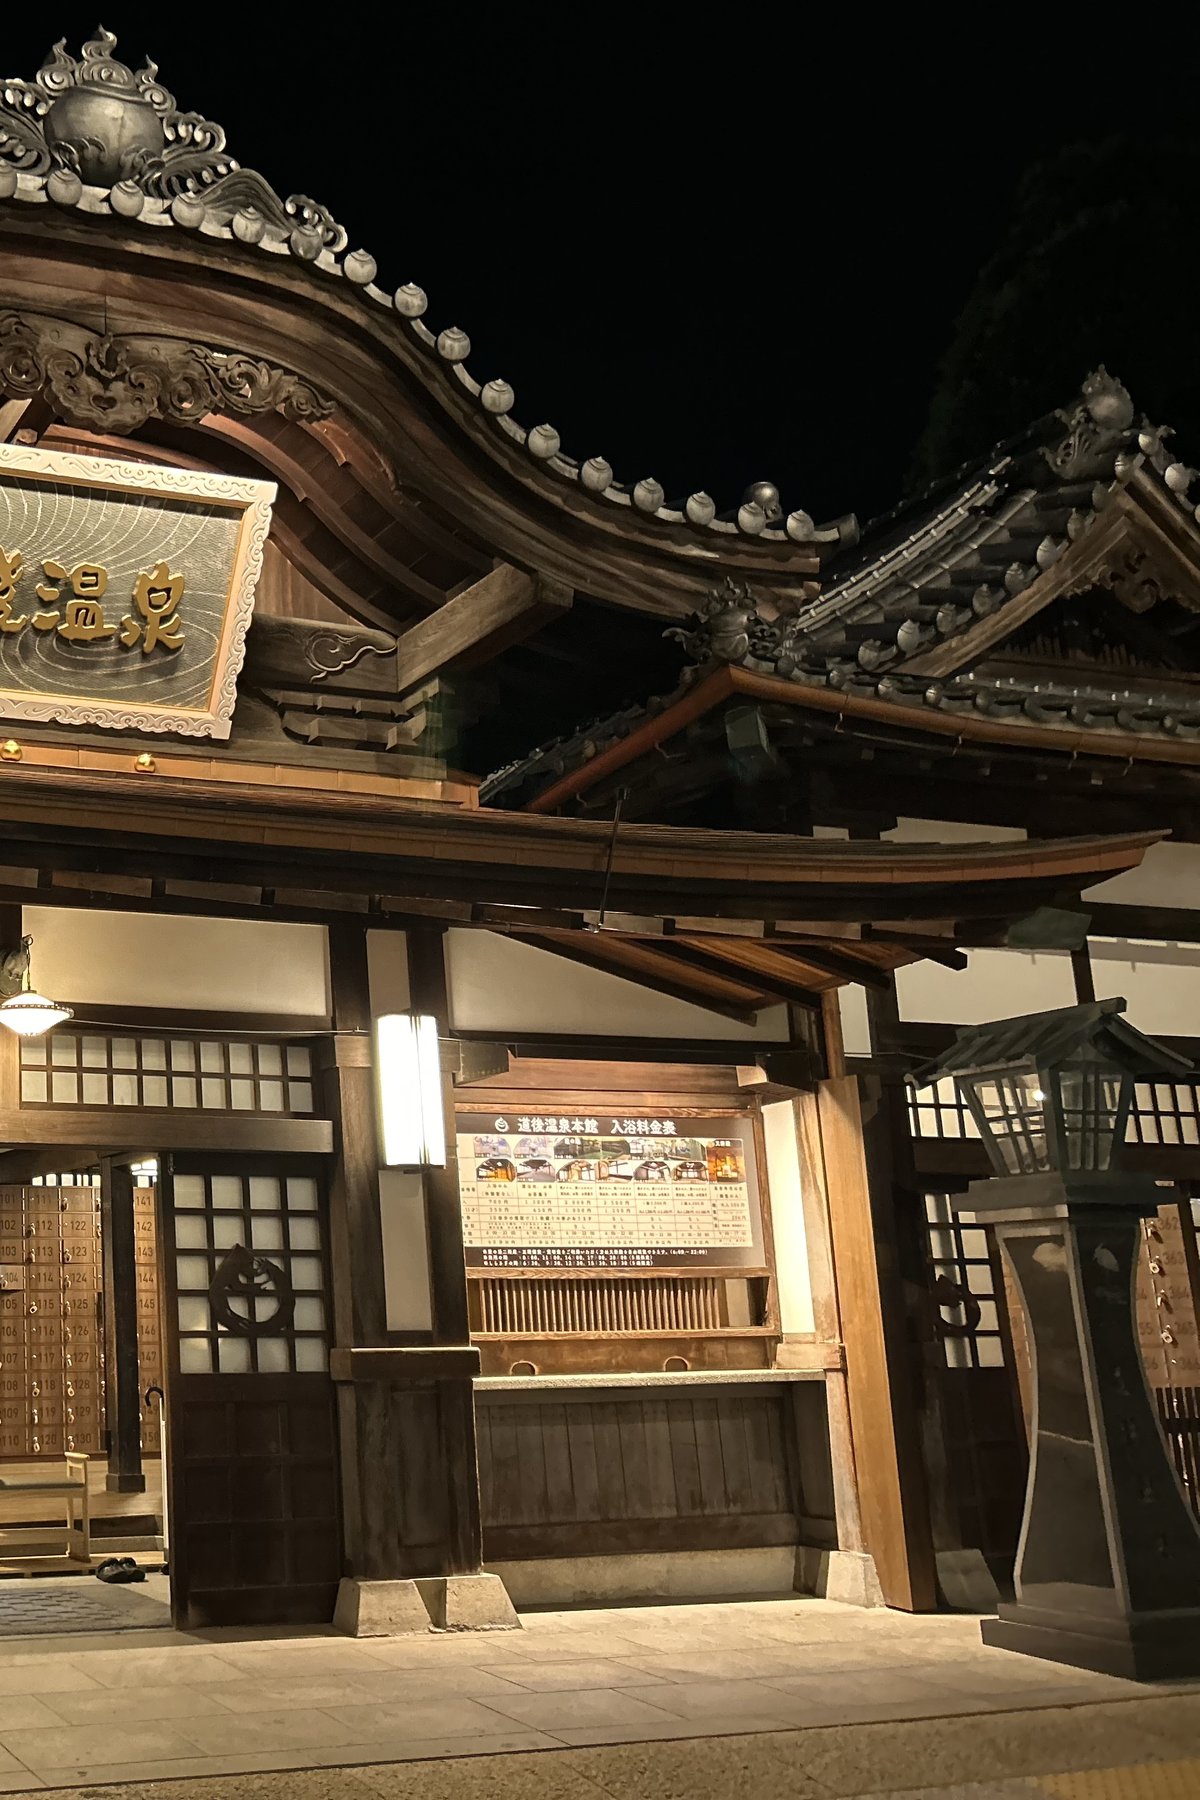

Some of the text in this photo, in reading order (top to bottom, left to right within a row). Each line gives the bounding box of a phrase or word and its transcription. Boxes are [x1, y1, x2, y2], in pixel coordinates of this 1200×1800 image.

[517, 1116, 677, 1135] 道後温泉本館 入浴料金表
[1139, 1322, 1152, 1335] 55
